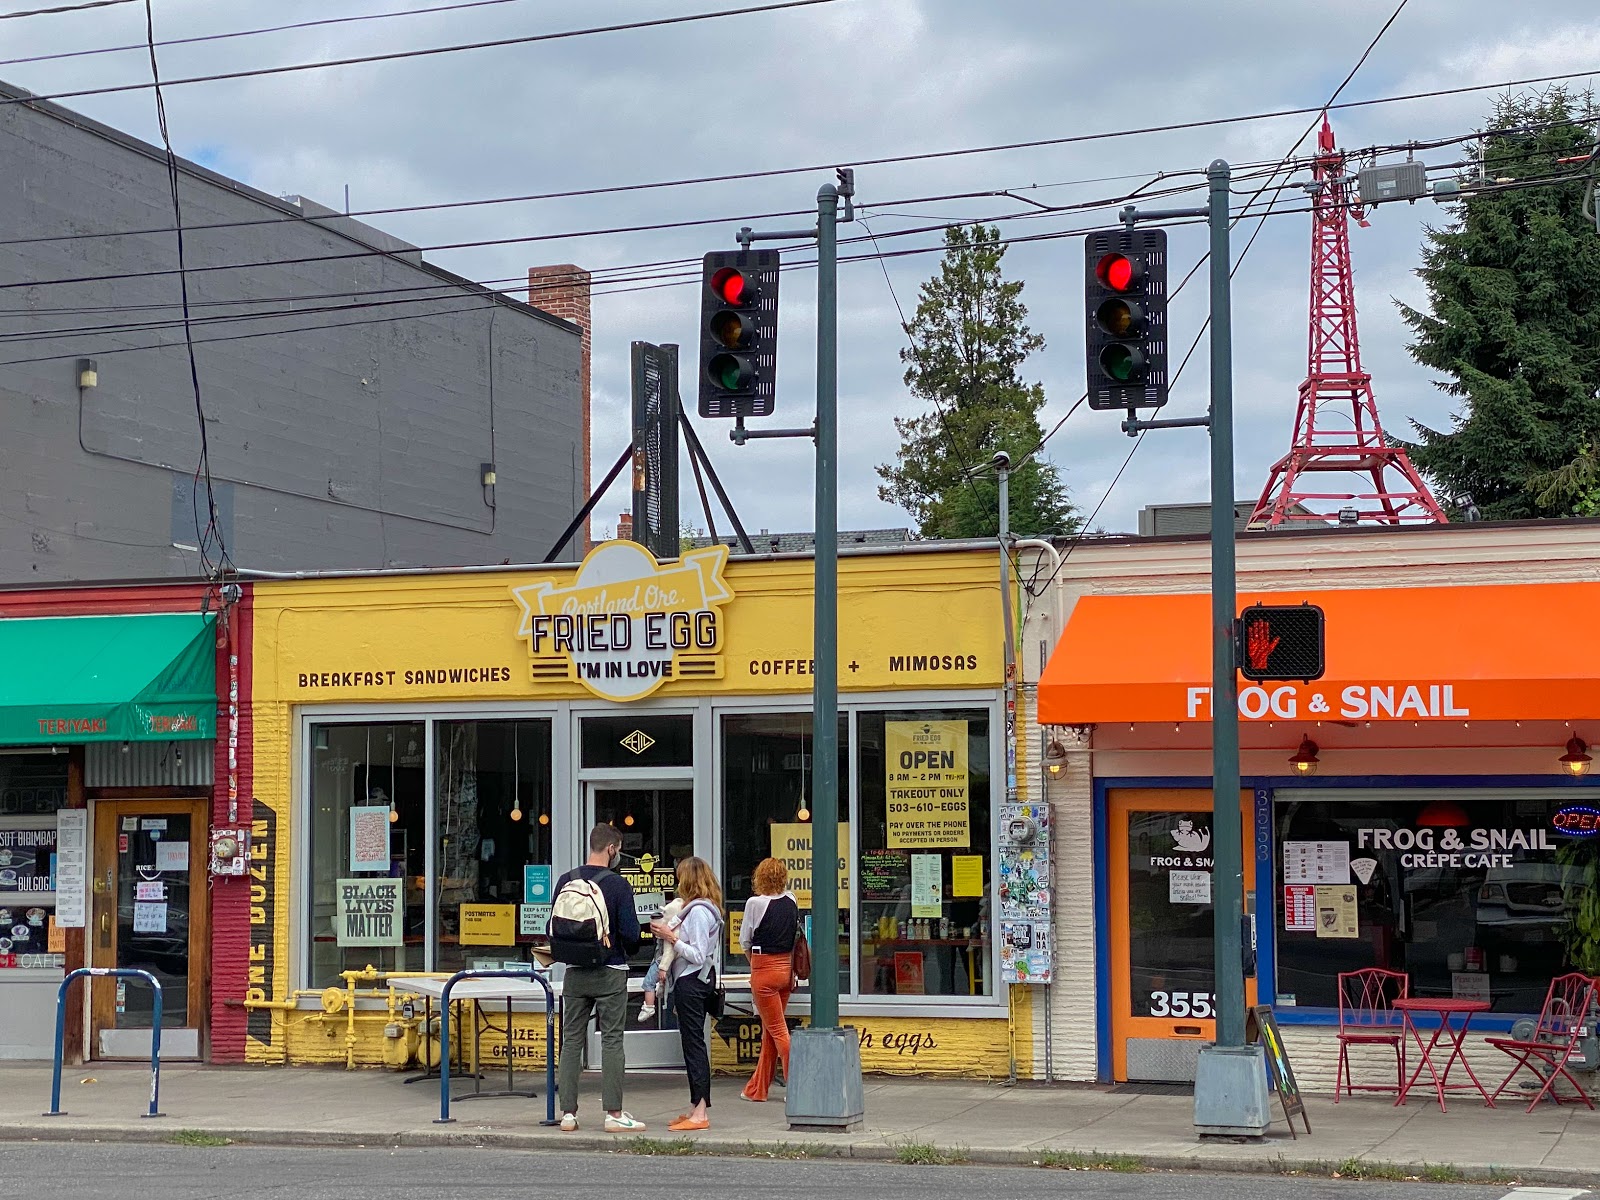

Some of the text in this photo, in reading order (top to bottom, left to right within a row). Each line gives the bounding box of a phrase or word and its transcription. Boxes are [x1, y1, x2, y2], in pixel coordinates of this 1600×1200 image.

[644, 584, 685, 607] Ore.
[531, 610, 717, 654] FRIED EGG
[576, 660, 673, 679] I'M IN LOVE
[889, 655, 977, 671] MIMOSAS
[298, 667, 511, 688] BREAKFAST SANDWICHES
[1187, 685, 1469, 718] FOG & SNAIL
[38, 718, 106, 735] TERIYAKI
[899, 750, 955, 770] OPEN
[889, 773, 894, 781] 8
[897, 773, 909, 781] AM
[920, 773, 926, 781] 2
[890, 788, 964, 799] TAKEOUT ONLY
[889, 802, 967, 813] 503-610-EGGS
[943, 820, 967, 828] PHONE
[18, 830, 57, 846] BIBIMBAP
[787, 838, 812, 851] ONL
[1357, 828, 1556, 850] FROG & SNAIL
[1150, 857, 1181, 866] FROG
[1183, 857, 1194, 867] &
[1400, 850, 1513, 868] CRÊPE CAFE
[250, 819, 268, 924] DOZEN
[18, 876, 50, 891] BULGOG
[653, 874, 675, 886] EGG
[342, 885, 397, 899] BLACK
[345, 899, 394, 913] LIVES
[638, 903, 659, 912] OPEN
[347, 914, 393, 938] MATTER
[21, 953, 63, 968] CAFE
[1150, 991, 1216, 1018] 355
[506, 1029, 539, 1040] IZE:
[739, 1024, 761, 1039] OP
[739, 1042, 761, 1057] HE
[882, 1032, 938, 1055] eggs
